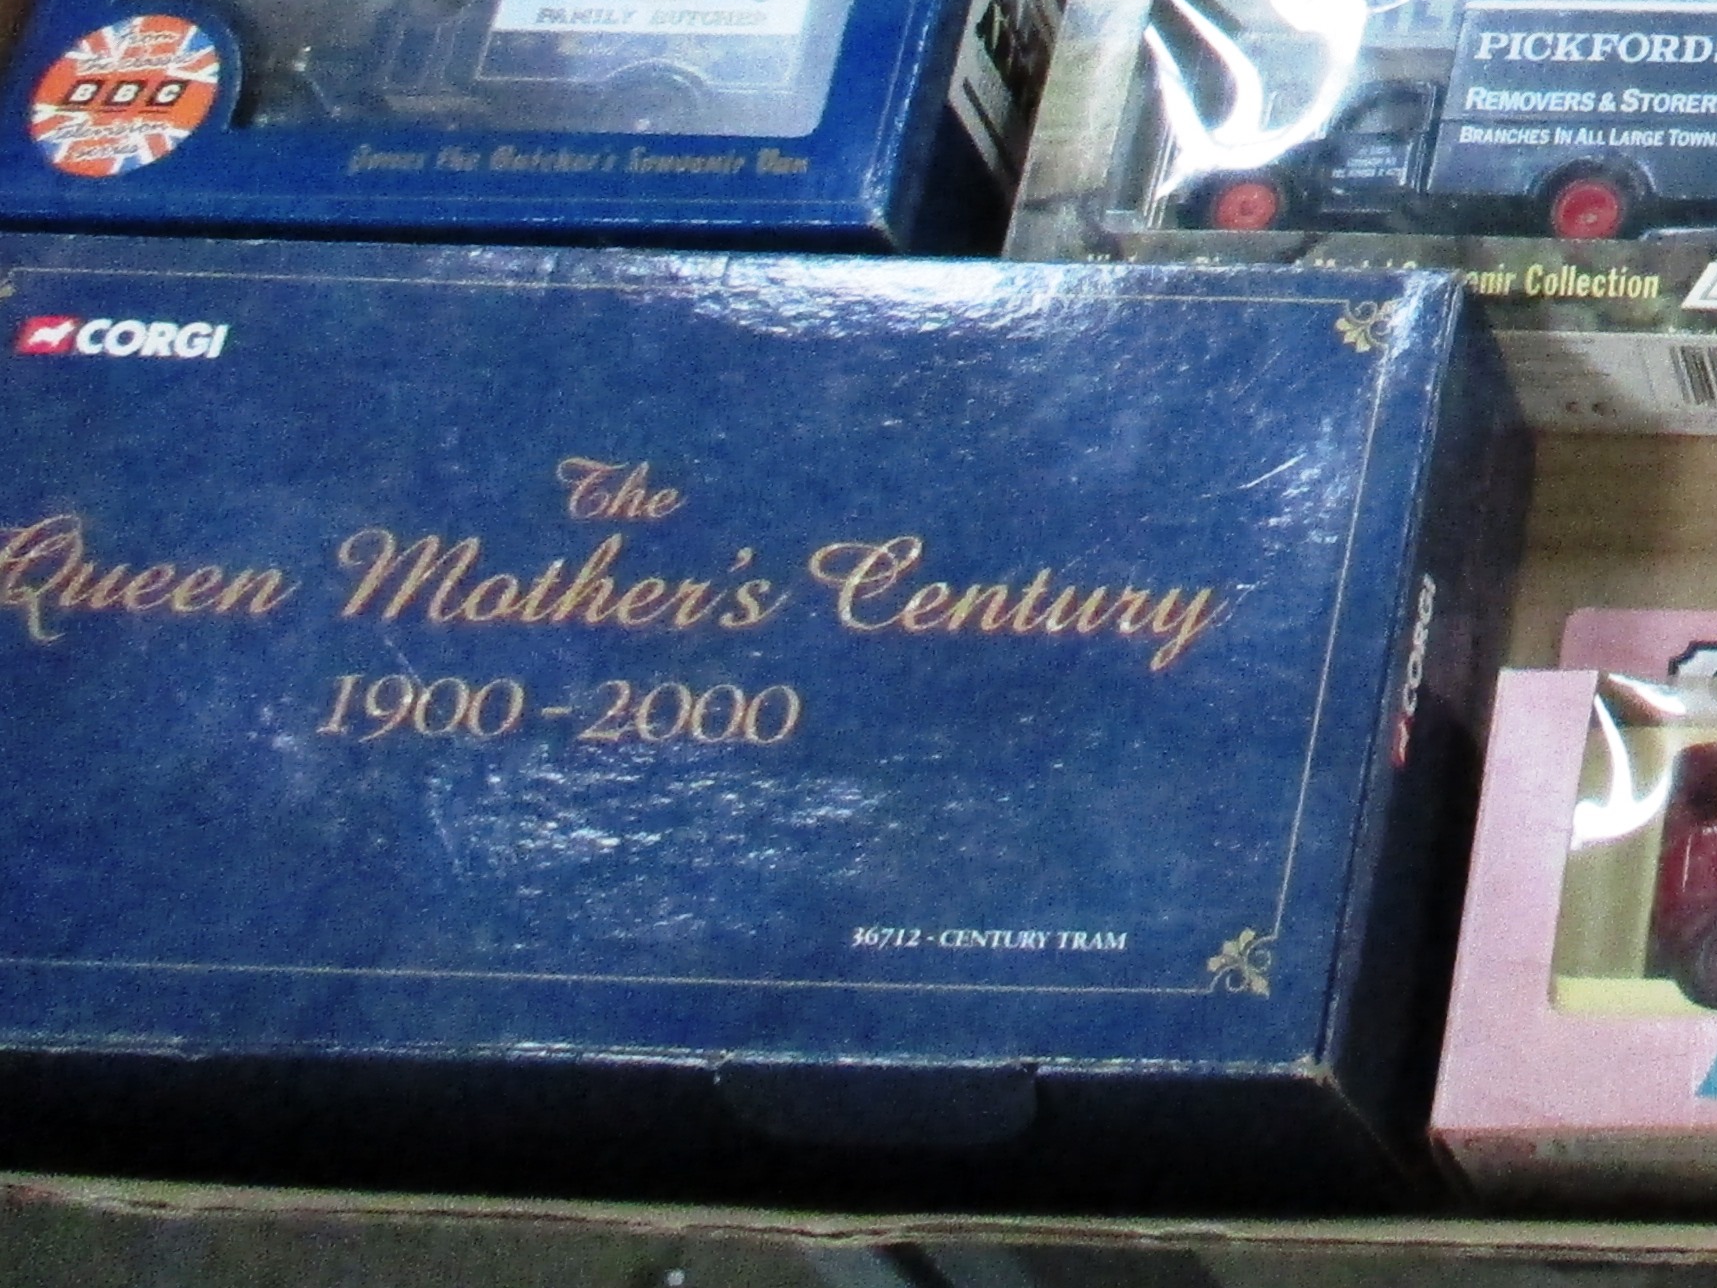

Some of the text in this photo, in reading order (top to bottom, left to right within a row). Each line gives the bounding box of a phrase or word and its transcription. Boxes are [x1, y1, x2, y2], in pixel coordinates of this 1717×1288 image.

[62, 79, 190, 106] BBC
[1465, 88, 1595, 114] REMOVERS
[1598, 91, 1618, 114] &
[1459, 127, 1550, 146] BRANCHES
[1555, 127, 1573, 146] IN
[1575, 128, 1606, 147] ALL
[1609, 128, 1664, 147] LARGE
[1523, 262, 1661, 300] Collection
[76, 317, 229, 359] CORGI
[555, 454, 681, 524] The
[0, 513, 1231, 672] Queen Mother's Century
[1403, 573, 1437, 717] CORGI
[851, 926, 1129, 952] 36712 CENTURY TRAM
